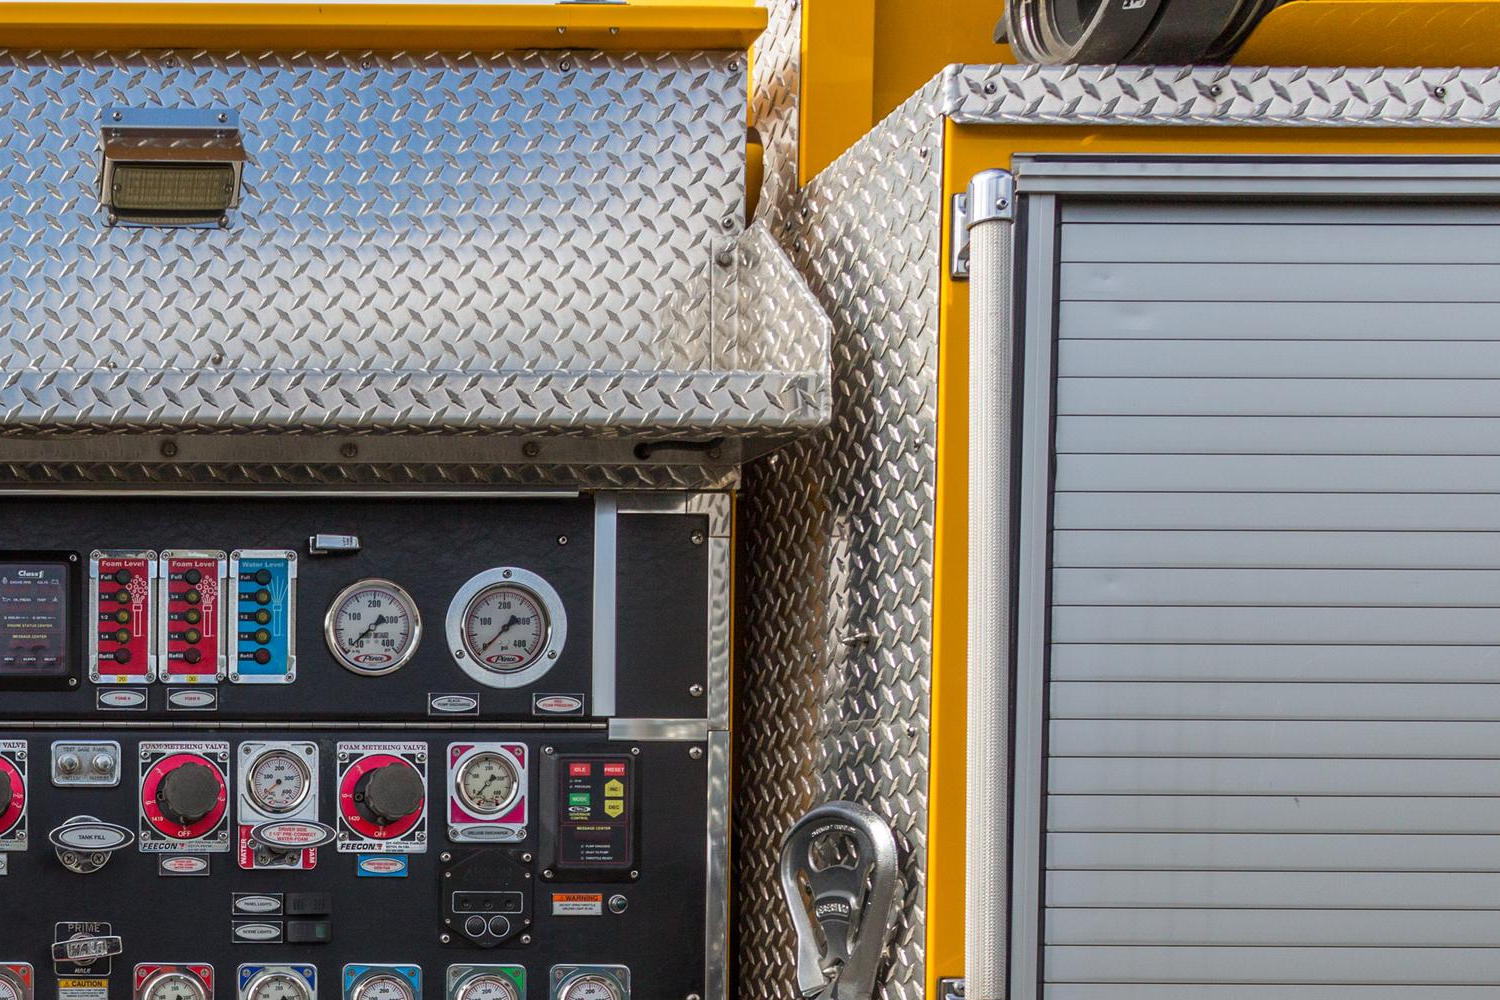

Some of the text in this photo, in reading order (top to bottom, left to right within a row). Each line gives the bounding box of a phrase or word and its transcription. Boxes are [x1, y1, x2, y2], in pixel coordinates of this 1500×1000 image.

[368, 600, 381, 608] 200
[498, 601, 511, 610] 200
[349, 612, 361, 620] 100
[385, 616, 398, 624] 300
[480, 617, 492, 626] 100
[381, 639, 395, 648] 400
[513, 639, 526, 648] 400
[68, 924, 100, 932] PRIME
